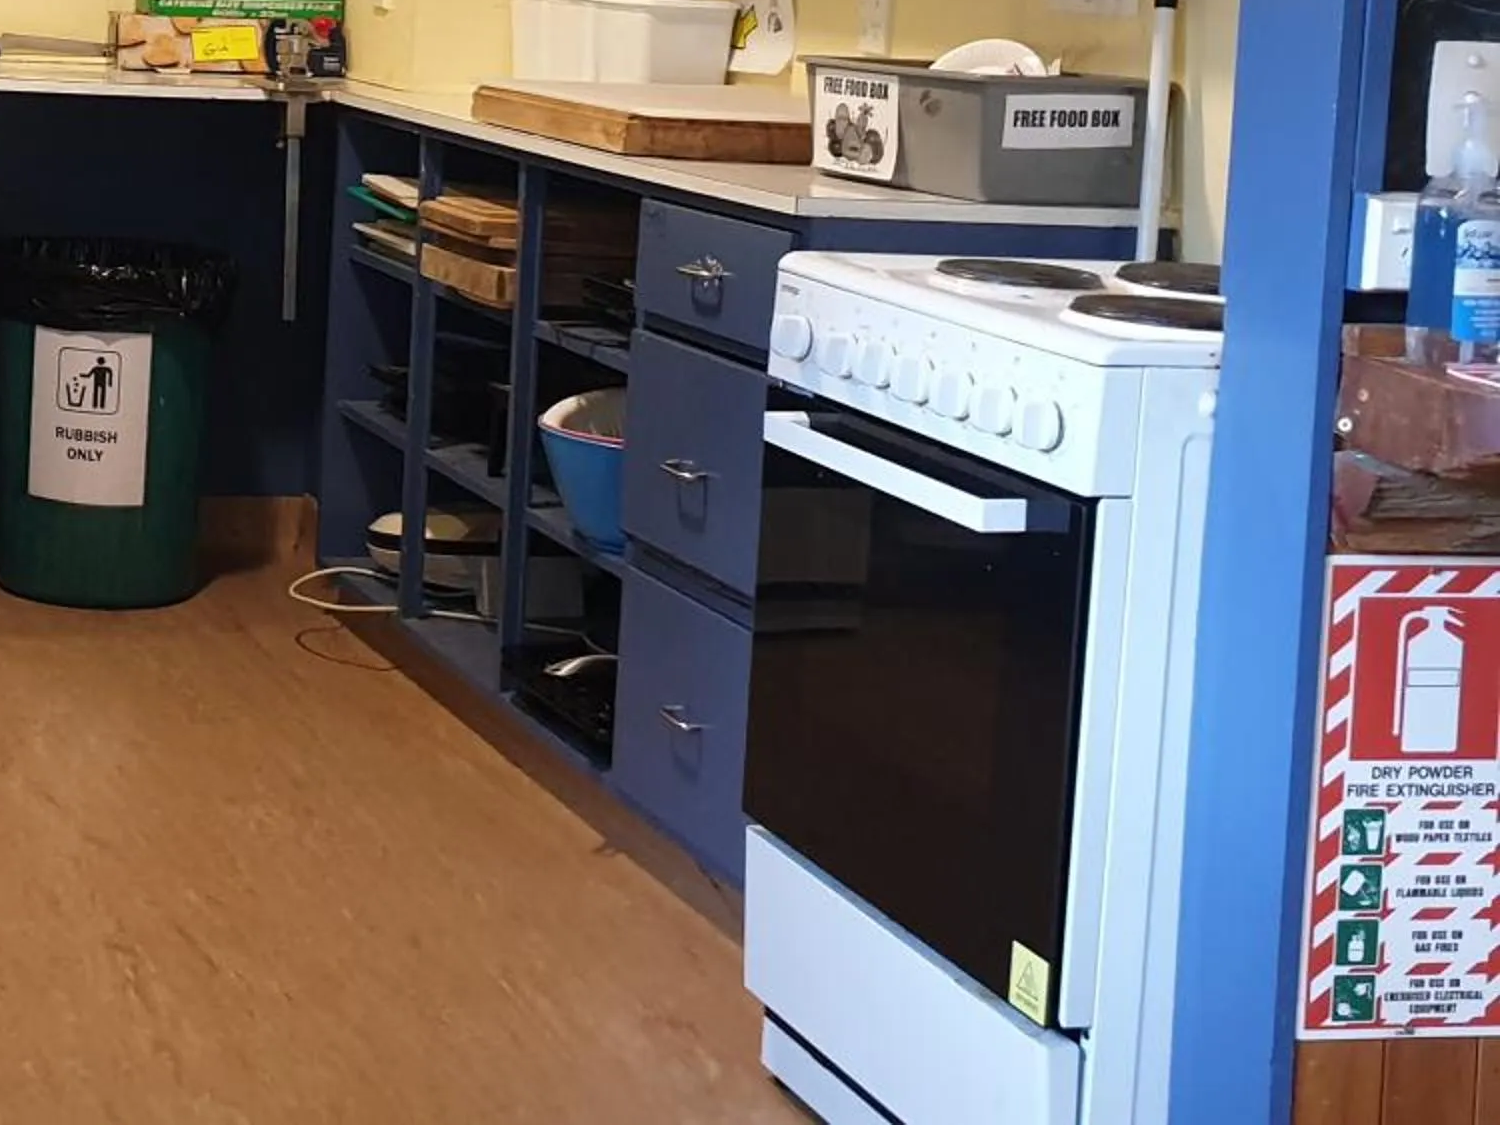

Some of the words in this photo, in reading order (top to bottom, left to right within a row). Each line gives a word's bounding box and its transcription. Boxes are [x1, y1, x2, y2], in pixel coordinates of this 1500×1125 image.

[823, 76, 843, 94] FREE
[844, 79, 868, 97] FOOD
[869, 82, 889, 100] BOX
[1013, 110, 1046, 128] FREE
[1049, 110, 1088, 128] FOOD
[1091, 110, 1121, 128] BOX
[55, 426, 118, 444] RUBBISH
[67, 448, 104, 462] ONLY
[1371, 766, 1402, 780] DRY
[1408, 765, 1474, 780] POWDER
[1347, 784, 1379, 797] FIRE
[1385, 782, 1496, 798] EXTINGUISHER
[1439, 820, 1456, 830] USE
[1423, 833, 1450, 842] PAPER
[1454, 832, 1493, 842] TEXTILES
[1435, 875, 1452, 885] USE
[1396, 888, 1447, 898] FLAMMABLE
[1451, 887, 1484, 898] LIQUIDS
[1415, 943, 1431, 952] GAS
[1434, 942, 1459, 952] FIRES
[1409, 1004, 1457, 1014] EQUIPMENT
